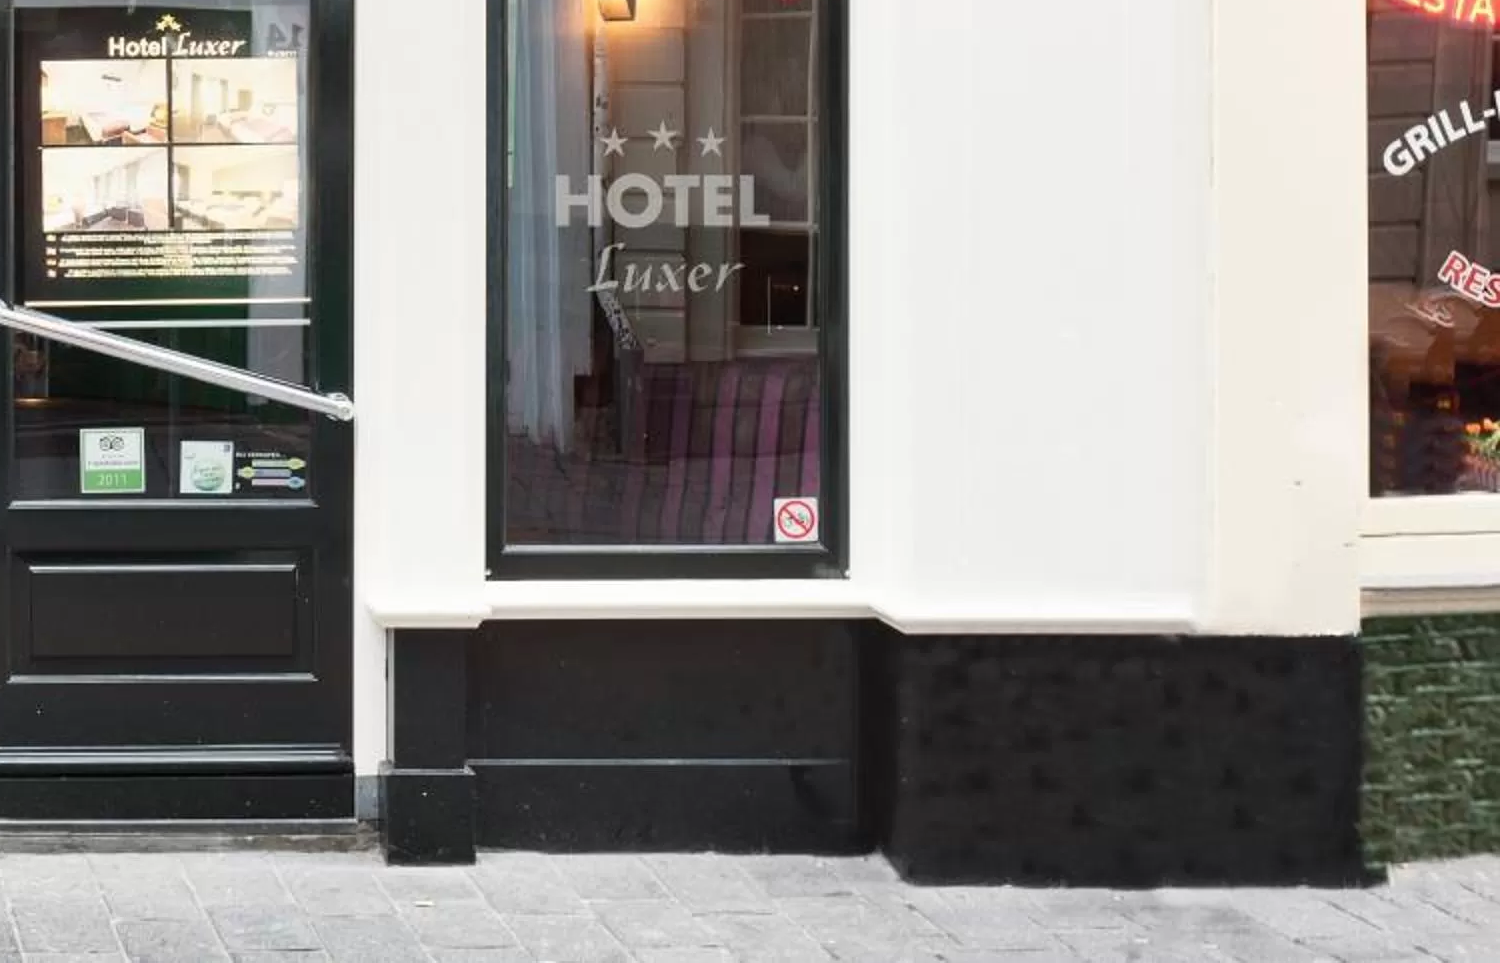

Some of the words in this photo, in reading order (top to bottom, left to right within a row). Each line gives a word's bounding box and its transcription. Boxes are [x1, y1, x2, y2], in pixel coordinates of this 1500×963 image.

[108, 36, 167, 57] Hotel
[171, 31, 247, 57] Luxer
[1382, 89, 1500, 177] GRILL-
[555, 172, 770, 228] HOTEL
[585, 242, 747, 293] Luxer
